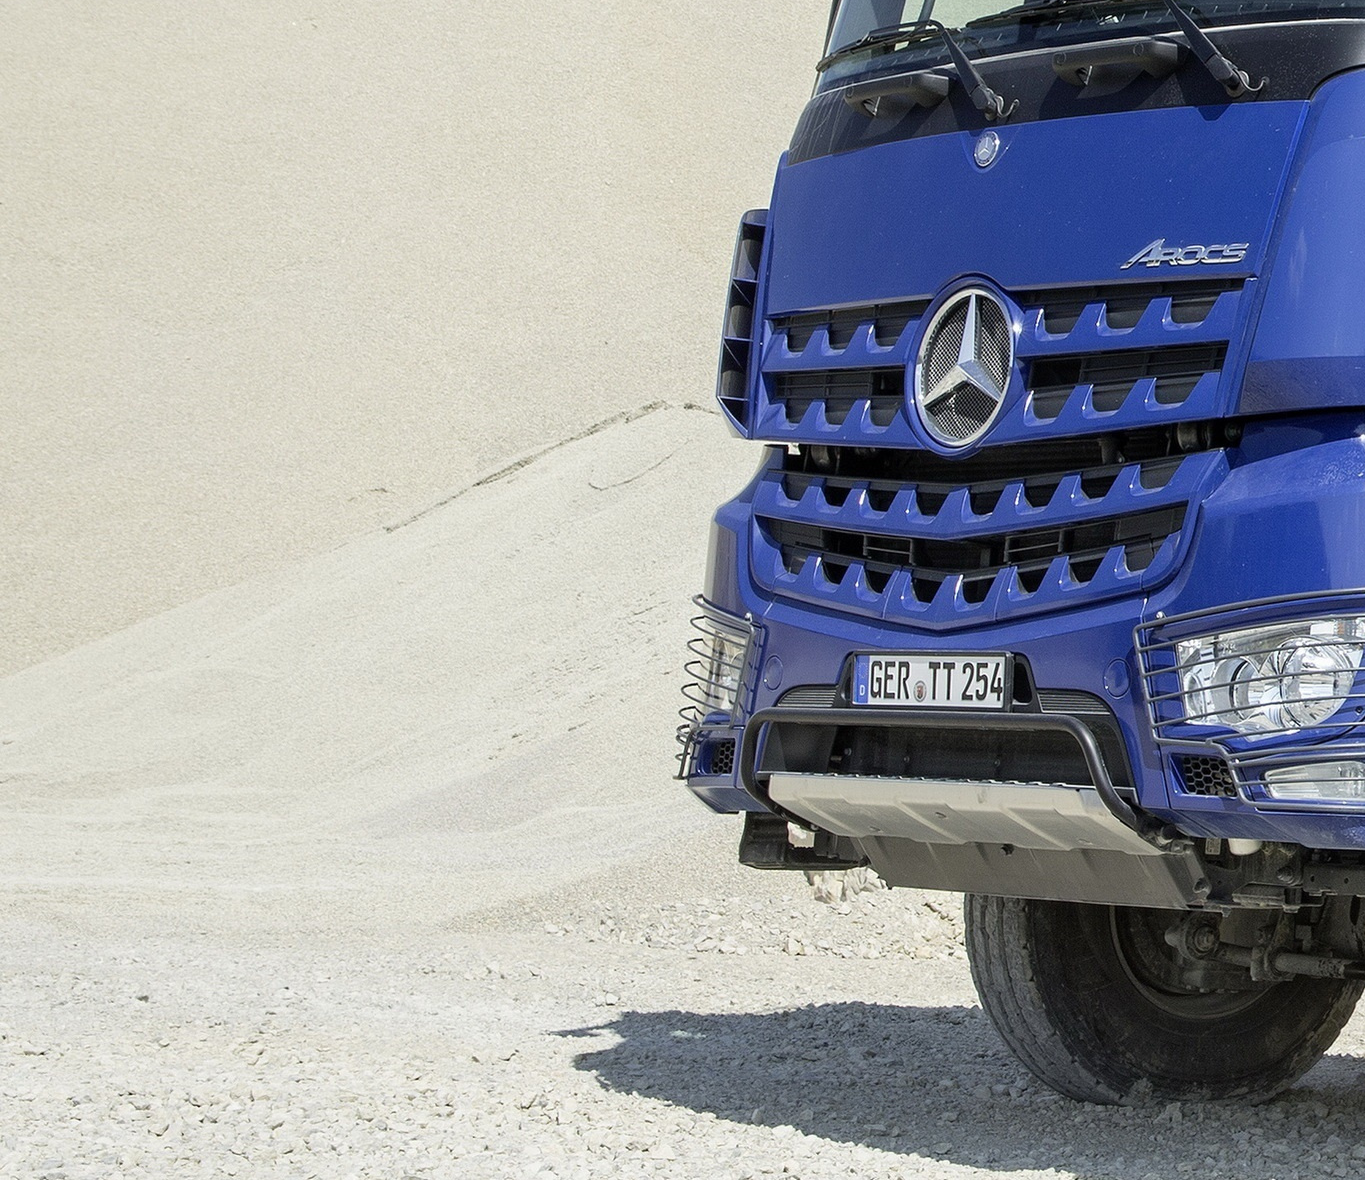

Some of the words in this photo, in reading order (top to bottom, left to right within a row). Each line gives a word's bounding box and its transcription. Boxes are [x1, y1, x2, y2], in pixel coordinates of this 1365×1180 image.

[859, 685, 866, 696] D
[870, 660, 910, 700] GER
[929, 661, 955, 700] TT
[961, 662, 1003, 701] 254
